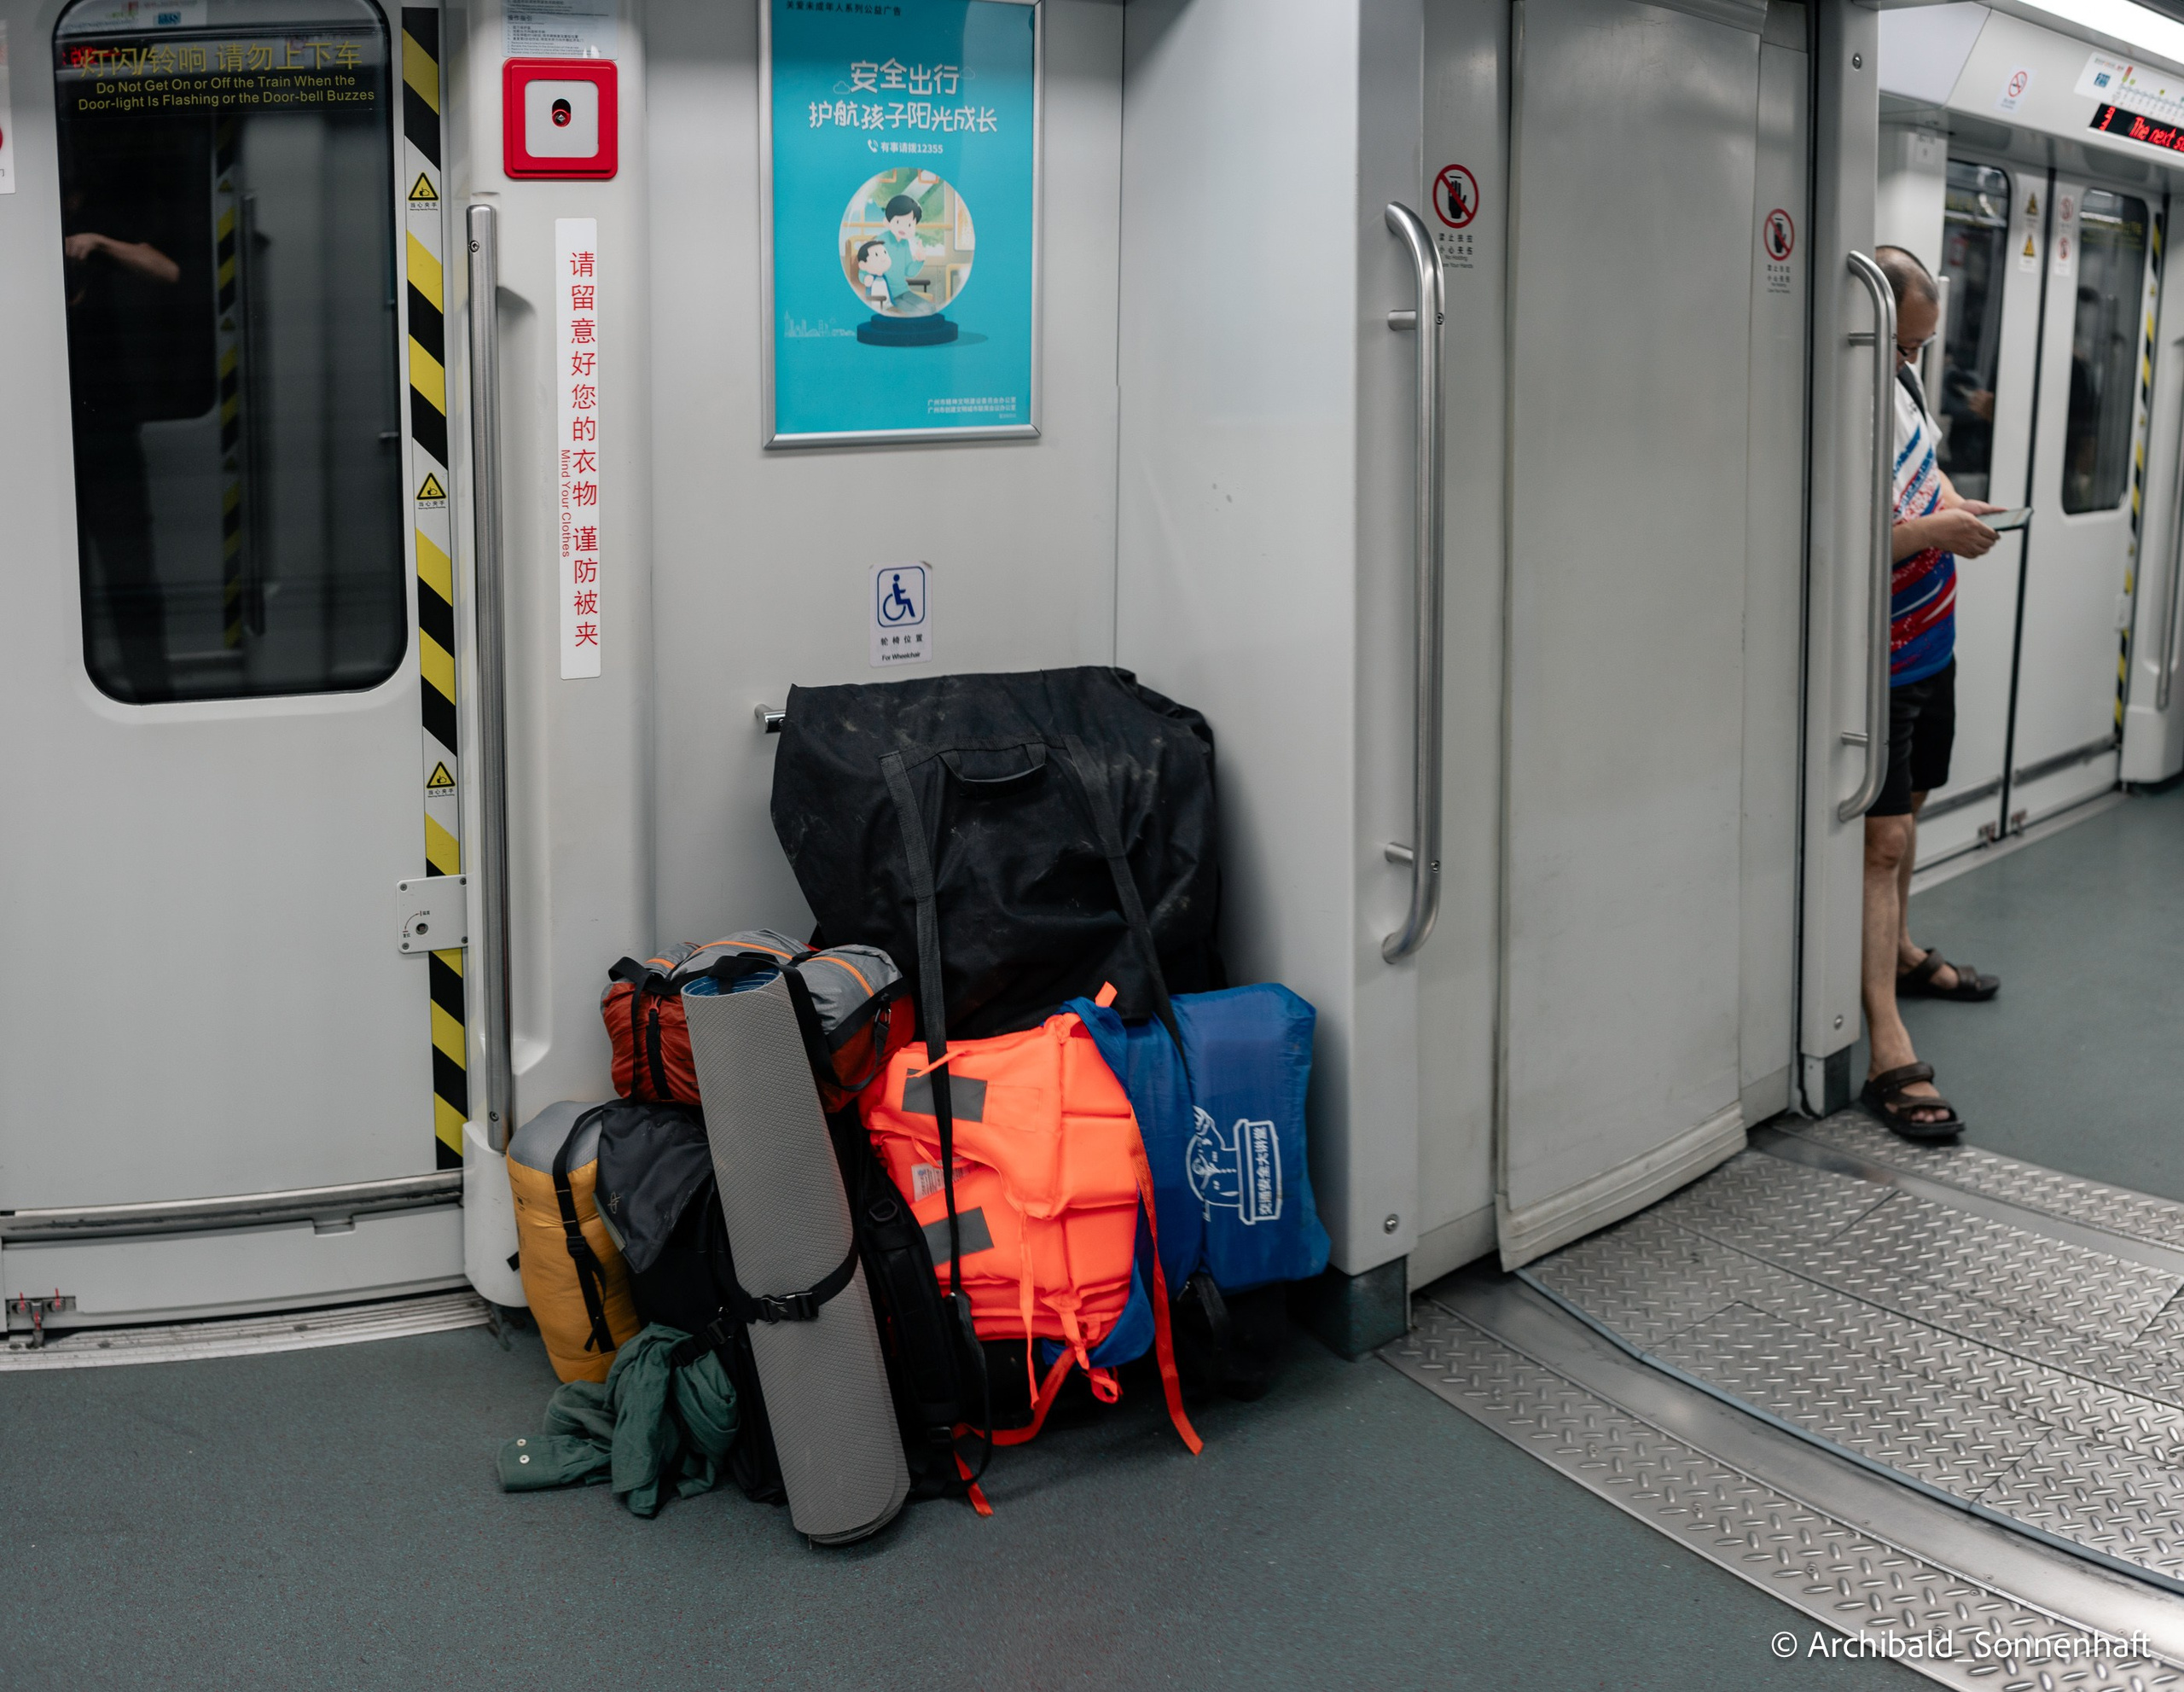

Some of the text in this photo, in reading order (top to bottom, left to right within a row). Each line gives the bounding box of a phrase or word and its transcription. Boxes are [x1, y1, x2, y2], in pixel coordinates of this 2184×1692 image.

[80, 46, 206, 78] 灯闪/铃响
[216, 41, 363, 73] 请勿上下车
[96, 75, 356, 94] Do Not Get On or Off the Train When the
[850, 57, 959, 96] 安全出行
[78, 90, 375, 110] Door-light Is Flashing or the Door-bell Buzzes
[809, 100, 997, 132] 护航孩子阳光成长
[2129, 115, 2150, 141] The
[2148, 127, 2177, 148] next
[880, 142, 944, 154] 有事请拨12355
[570, 251, 599, 647] 请留意好您的衣物 谨防被夹
[561, 449, 572, 557] Mind Your Clothes
[880, 634, 923, 646] 轮椅位置
[892, 652, 921, 660] Wheelchair
